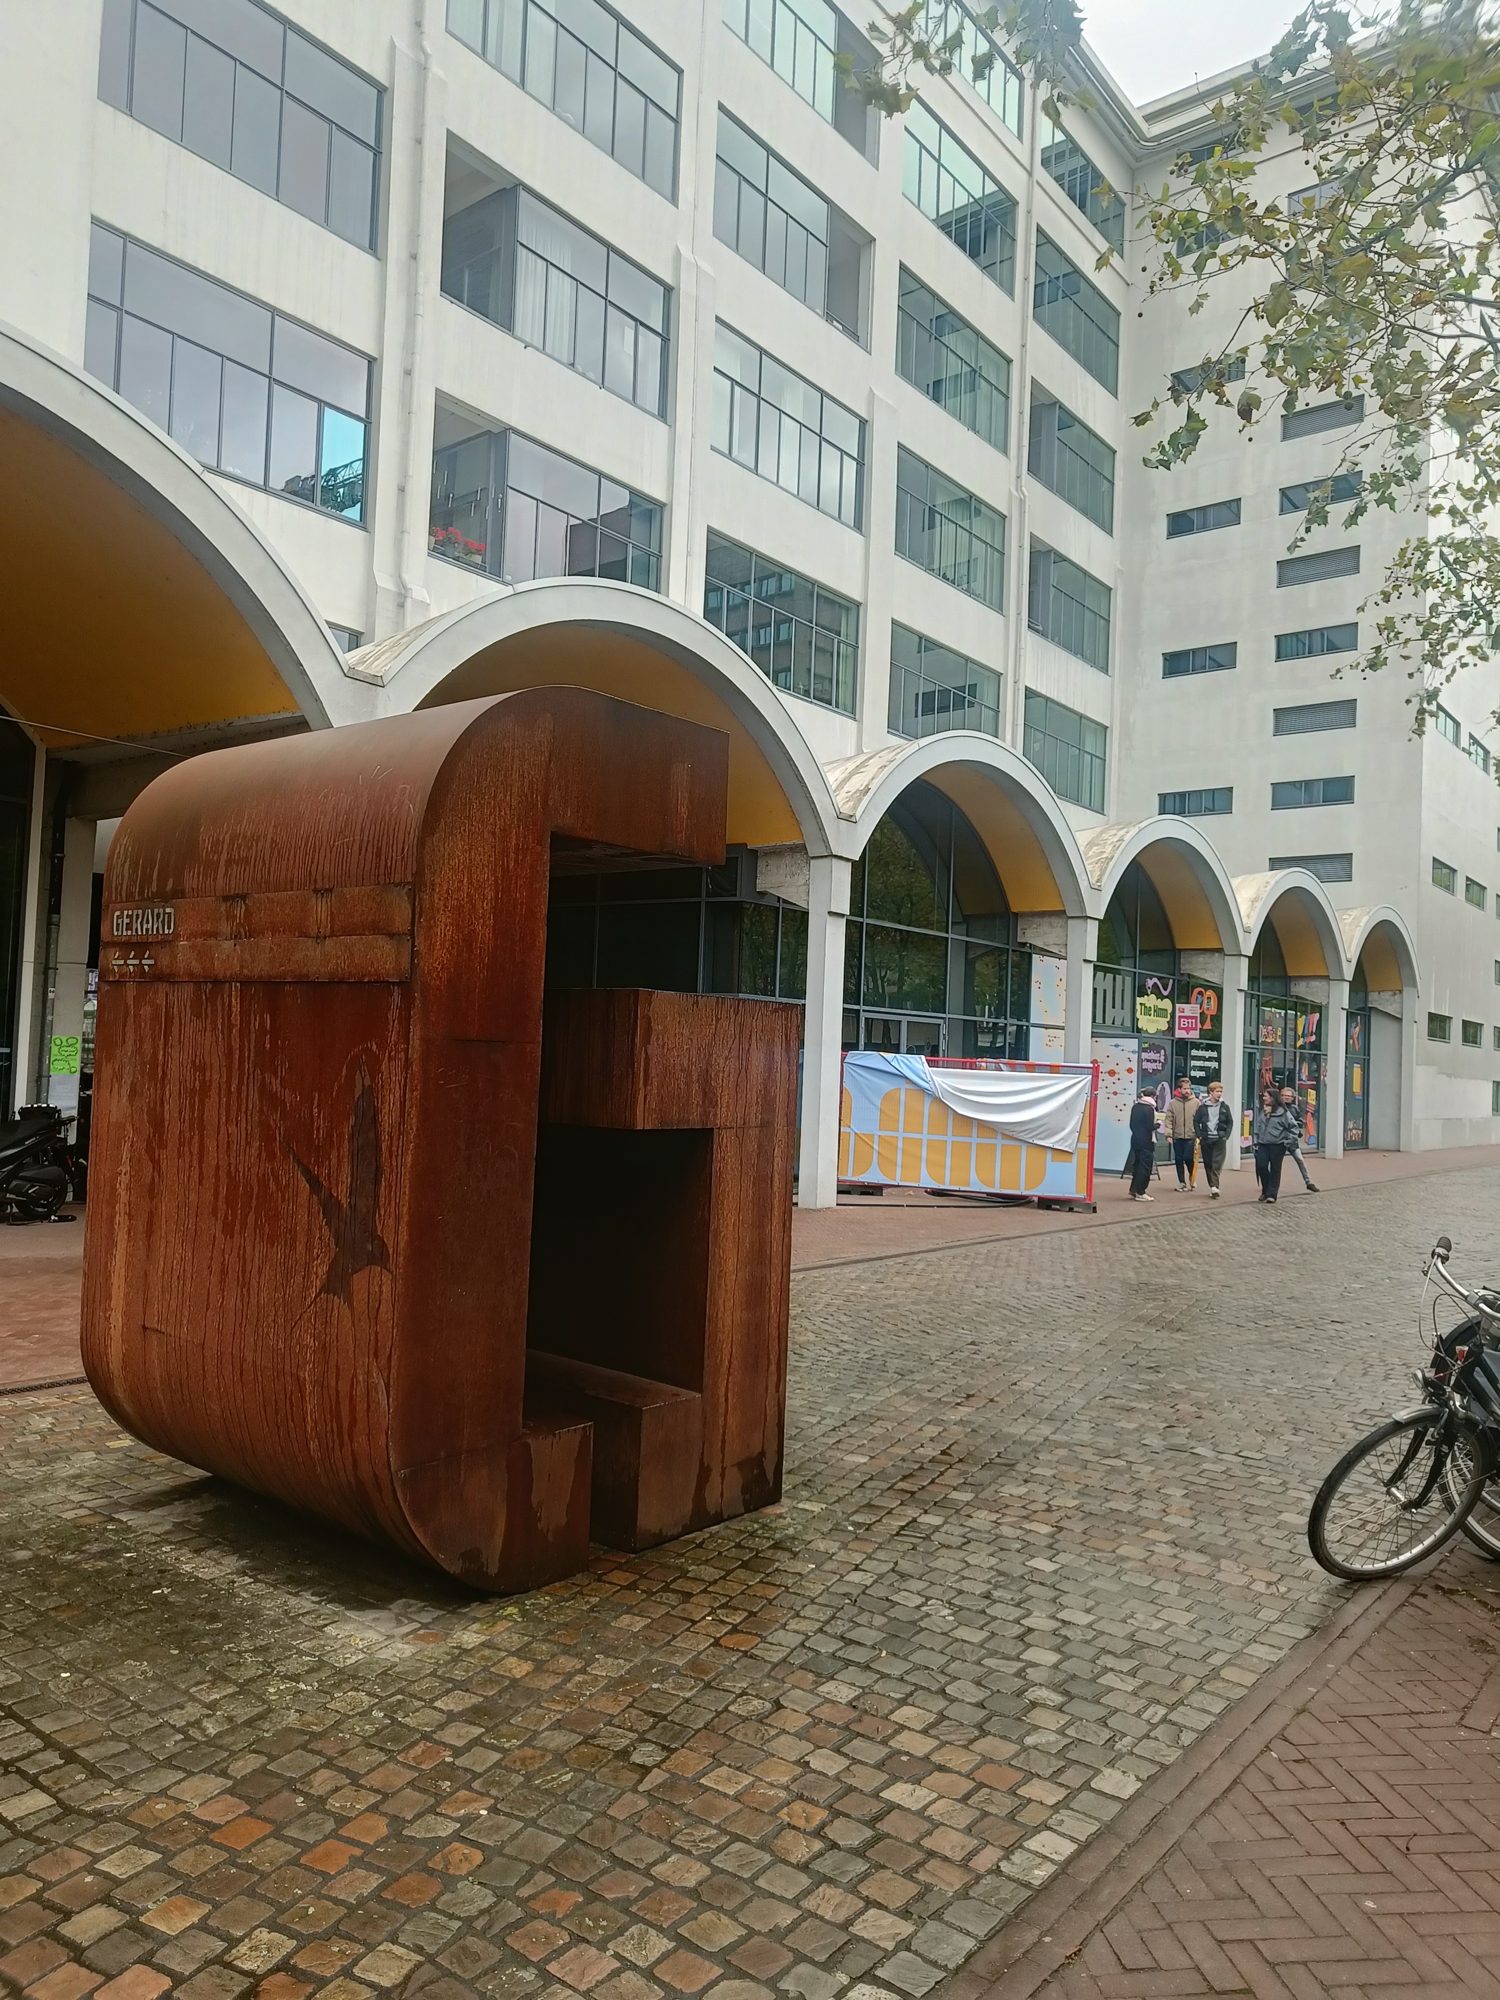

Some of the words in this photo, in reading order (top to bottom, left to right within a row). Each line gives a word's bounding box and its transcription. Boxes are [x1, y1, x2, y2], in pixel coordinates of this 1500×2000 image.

[113, 907, 175, 936] GERARD
[1139, 1002, 1152, 1017] The
[1180, 1018, 1196, 1028] B11
